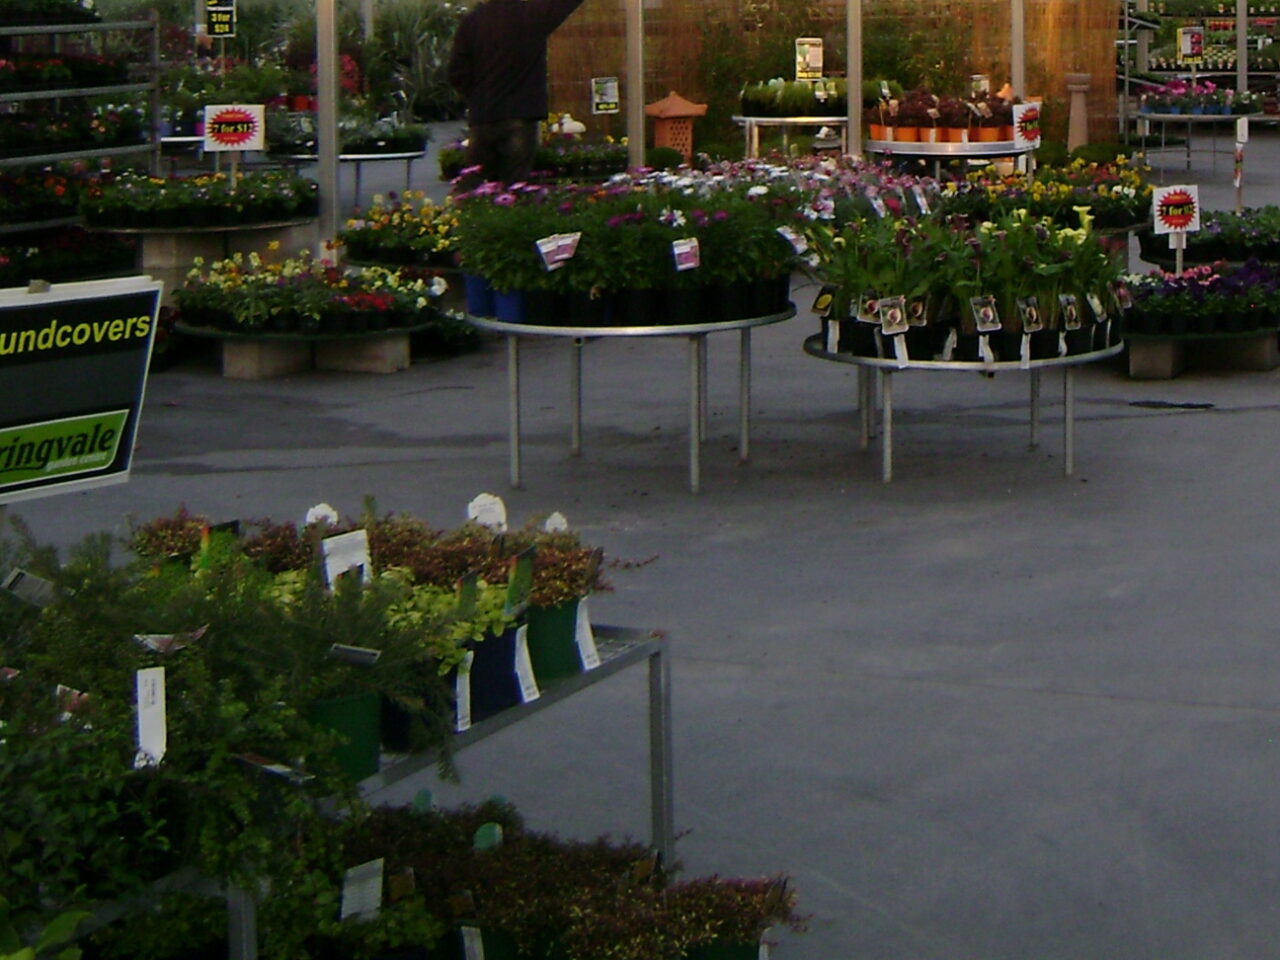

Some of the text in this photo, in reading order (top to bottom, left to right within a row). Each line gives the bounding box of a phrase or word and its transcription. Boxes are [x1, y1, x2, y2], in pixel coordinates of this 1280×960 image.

[221, 123, 235, 133] for
[1169, 205, 1183, 216] for
[0, 314, 151, 355] undcovers
